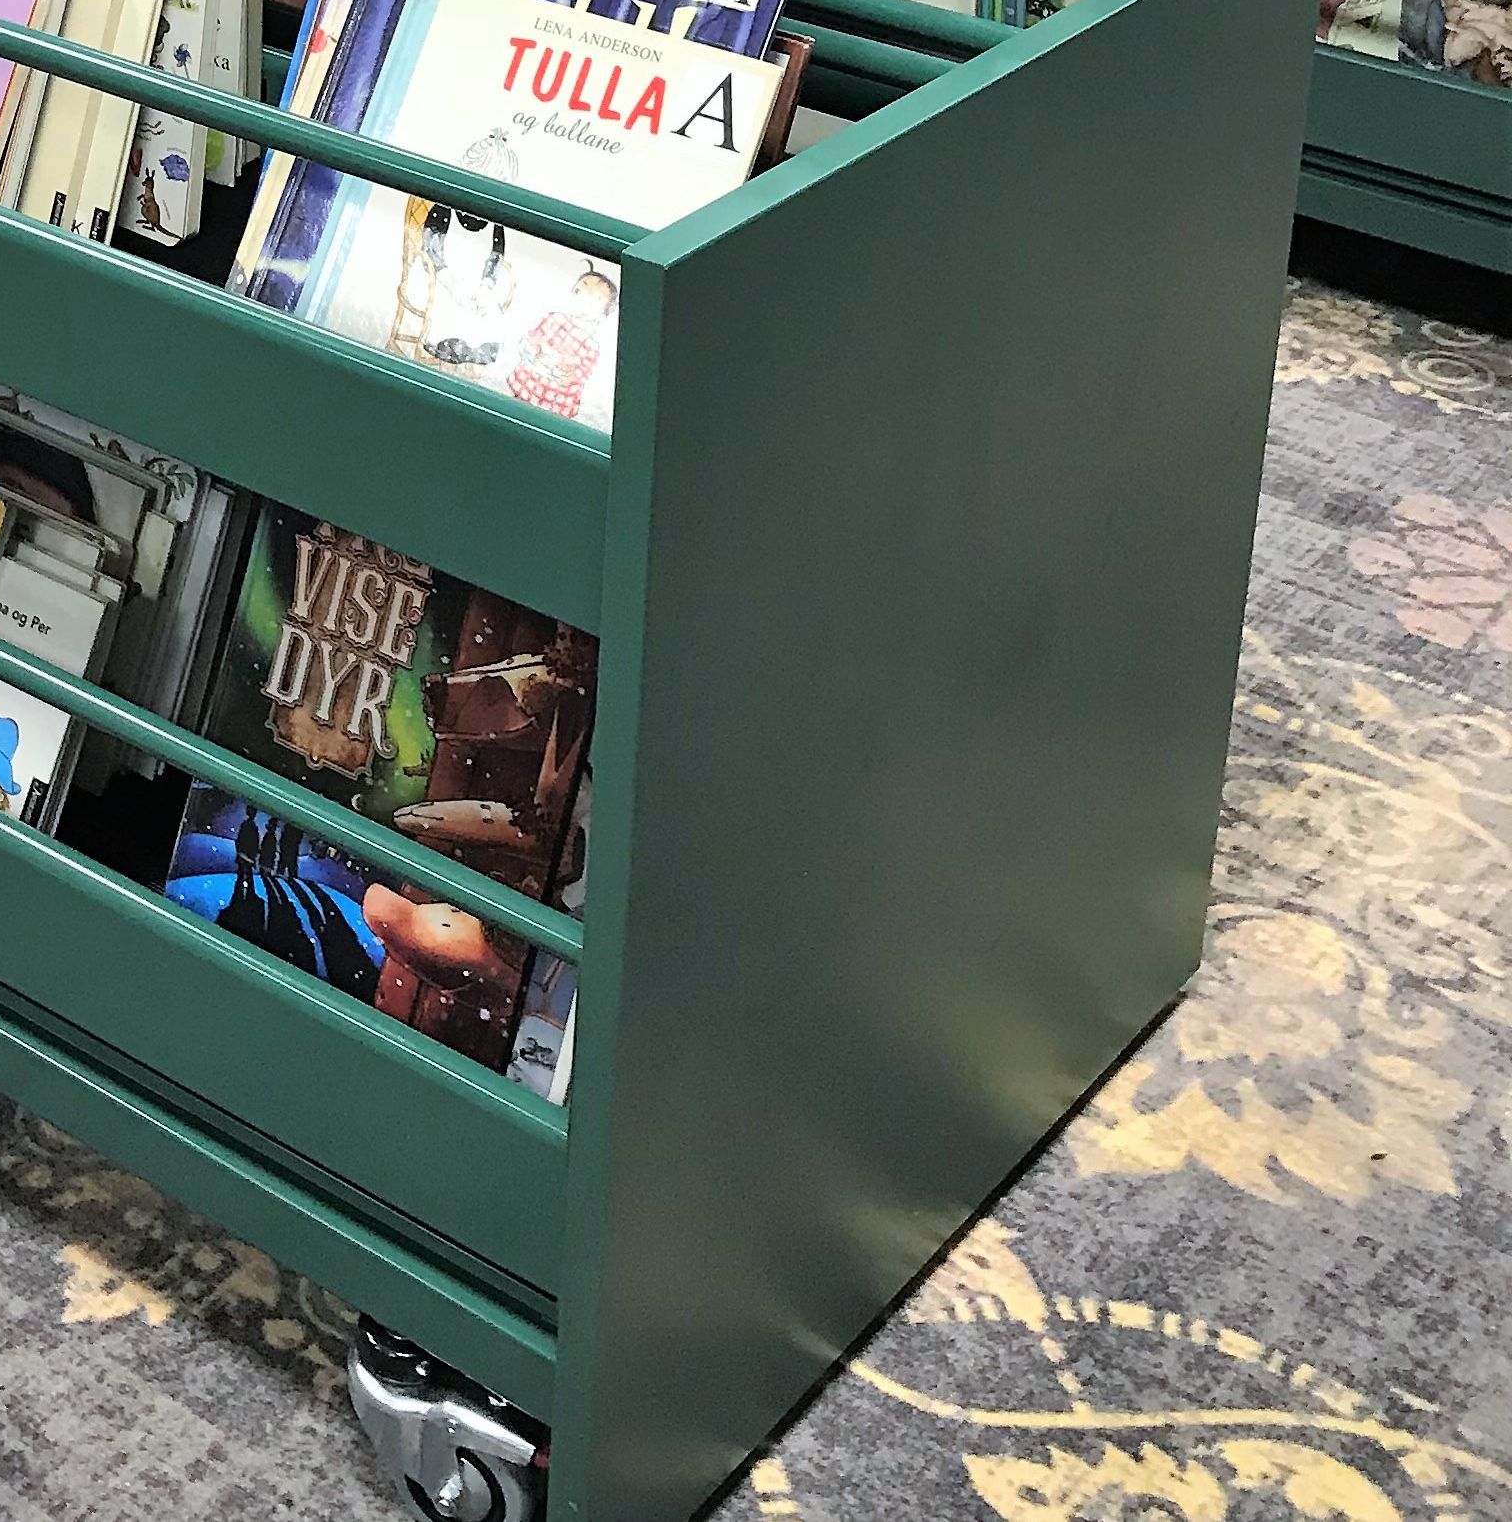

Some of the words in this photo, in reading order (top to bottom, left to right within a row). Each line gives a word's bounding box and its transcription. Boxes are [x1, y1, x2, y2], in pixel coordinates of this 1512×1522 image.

[534, 17, 573, 39] LENA
[578, 32, 663, 63] ANDERSON
[503, 37, 666, 135] TULLA
[670, 72, 740, 154] A
[512, 111, 540, 136] og
[543, 112, 625, 154] bollane
[12, 608, 28, 628] og
[30, 615, 52, 636] Per
[289, 534, 430, 668] VISE
[262, 619, 397, 759] DYR
